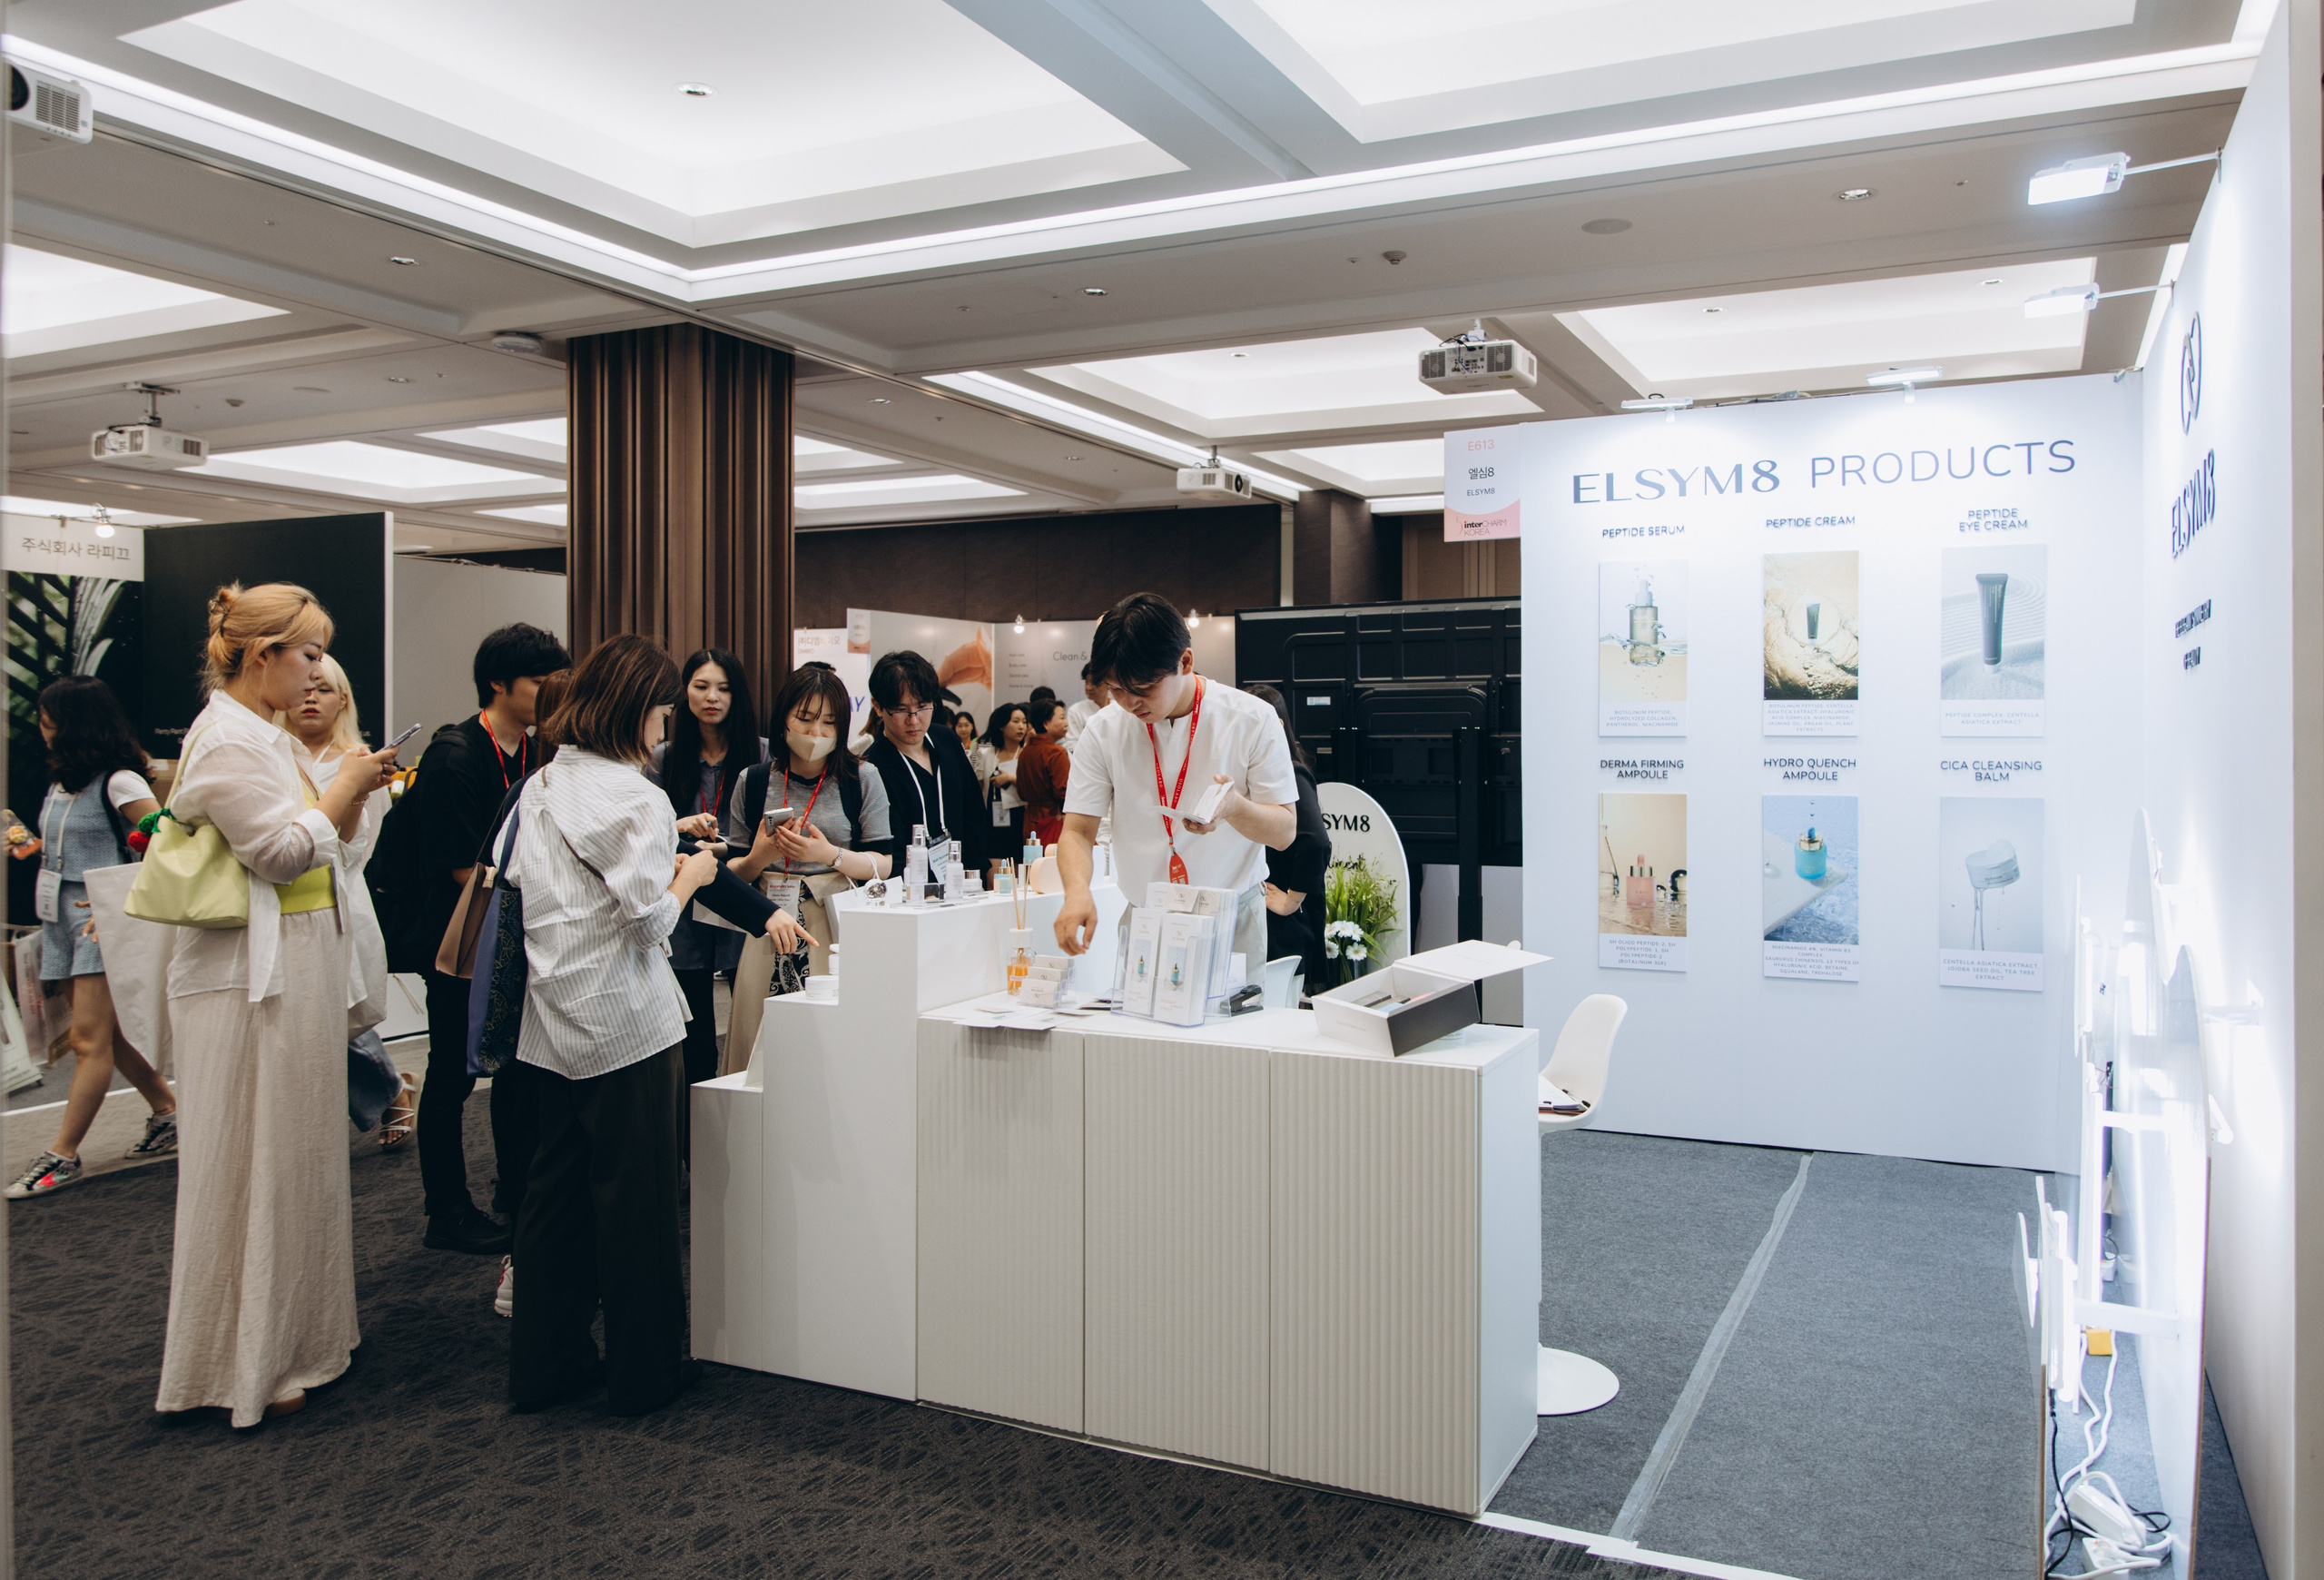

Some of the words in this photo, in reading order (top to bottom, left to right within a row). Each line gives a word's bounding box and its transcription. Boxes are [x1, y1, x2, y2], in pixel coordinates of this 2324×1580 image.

[1468, 439, 1494, 451] E613
[1468, 467, 1494, 479] 엘심8
[1573, 459, 1780, 504] ELSYM8
[1811, 439, 2075, 489] PRODUCTS
[1466, 488, 1495, 496] ELSYM8
[1968, 508, 2018, 519] PEPTIDE
[1766, 518, 1811, 528] PEPTIDE
[1815, 516, 1856, 526] CREAM
[1959, 521, 1980, 532] EYE
[1984, 519, 2028, 531] CREAM
[1601, 527, 1645, 538] PEPTIDE
[1648, 525, 1685, 536] SERUM
[22, 538, 84, 557] 주식회사
[87, 544, 131, 560] 라피끄
[1053, 651, 1078, 661] Clean
[1080, 651, 1088, 661] &
[1600, 759, 1638, 768] DERMA
[1640, 759, 1684, 768] FIRMING
[1764, 758, 1804, 767] HYDRO
[1807, 758, 1856, 768] QUENCH
[1940, 760, 1968, 770] CICA
[1972, 760, 2043, 770] CLEANSING
[1617, 770, 1669, 779] AMPOULE
[1782, 771, 1838, 781] AMPOULE
[1974, 772, 2009, 782] BALM
